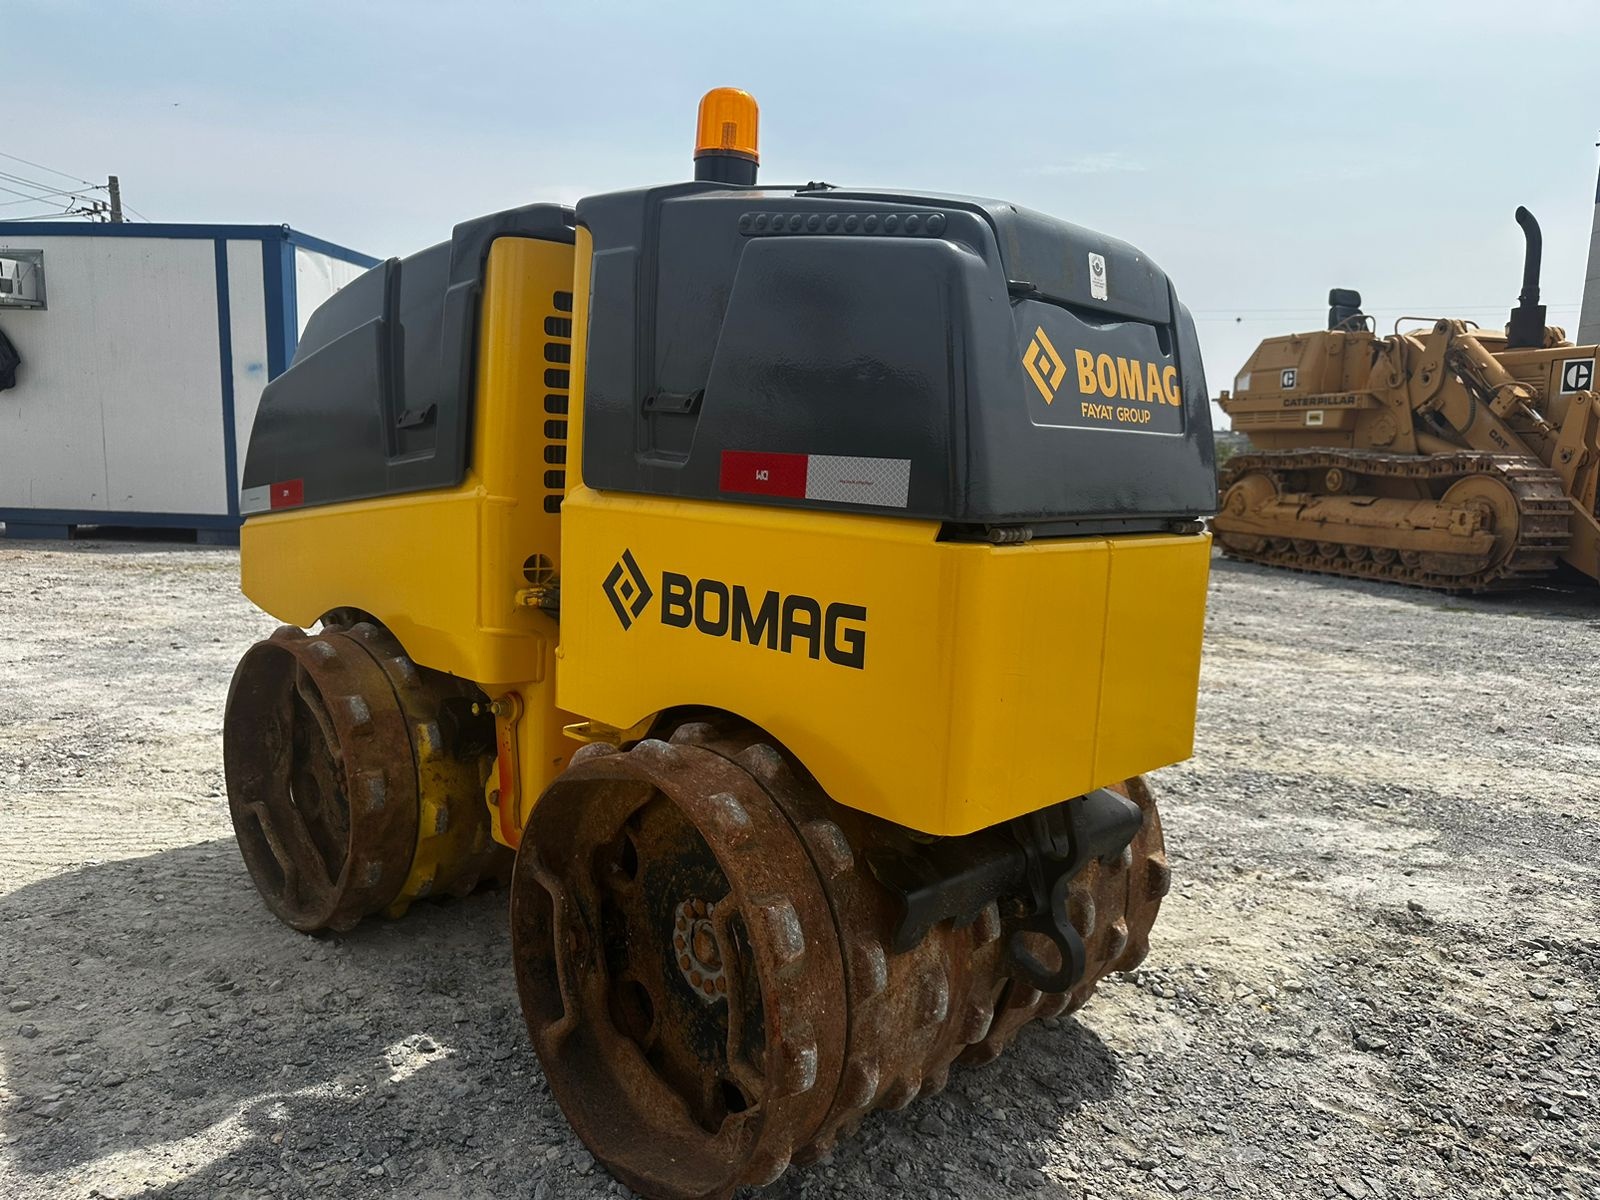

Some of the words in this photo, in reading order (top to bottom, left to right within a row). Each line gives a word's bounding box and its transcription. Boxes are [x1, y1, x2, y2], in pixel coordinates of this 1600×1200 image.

[1075, 349, 1181, 406] BOMAG
[1284, 396, 1354, 406] CATERPILLAR
[1081, 403, 1113, 420] FAYAT
[1116, 407, 1150, 423] GROUP
[1489, 430, 1509, 449] CAT
[661, 571, 866, 670] BOMAG
